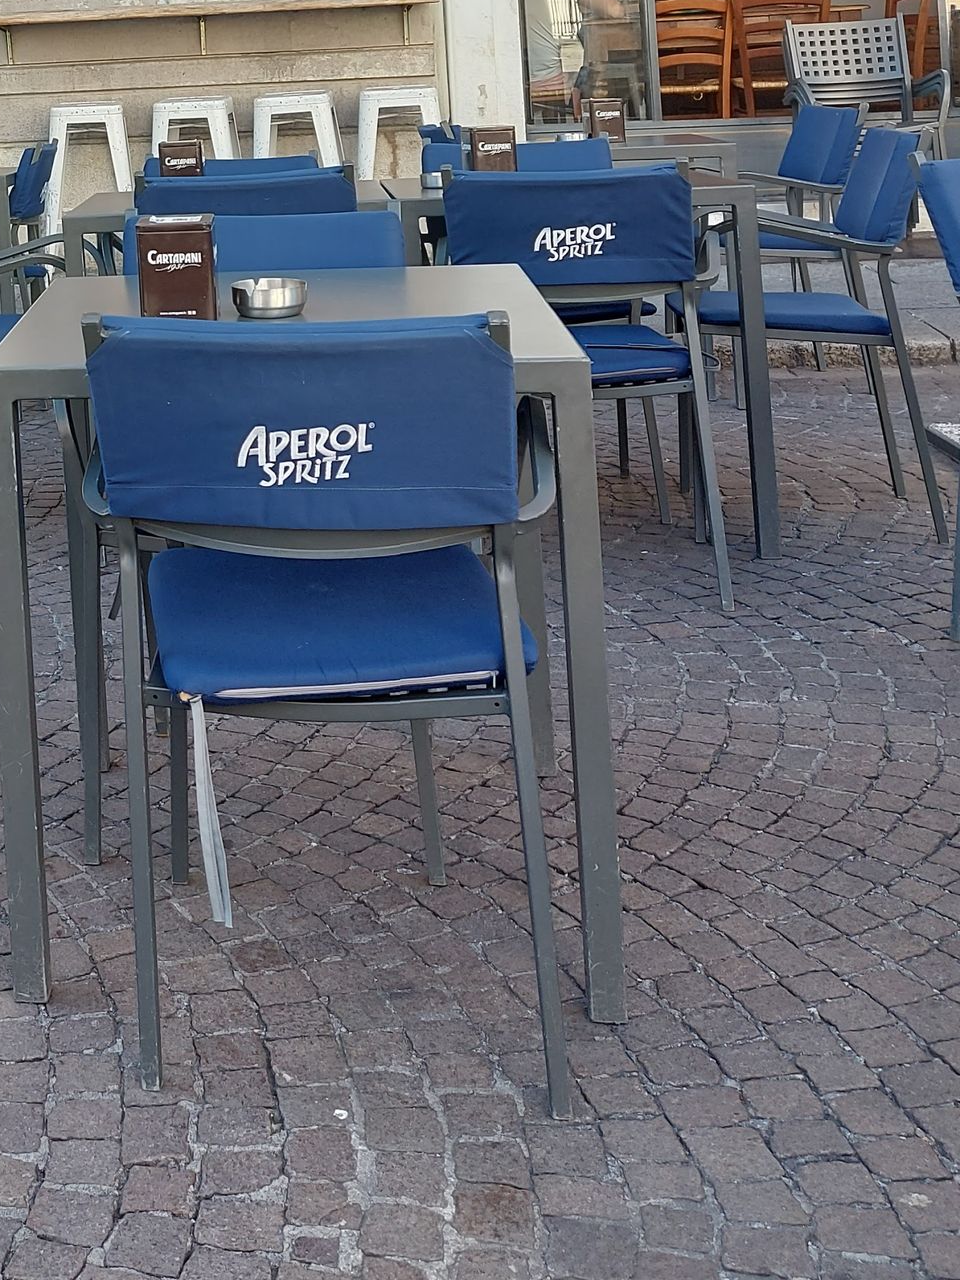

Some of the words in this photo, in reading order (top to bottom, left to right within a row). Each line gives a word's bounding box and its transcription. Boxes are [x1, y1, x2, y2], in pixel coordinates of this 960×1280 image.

[533, 222, 616, 252] APEROL
[147, 249, 202, 265] CARTAPANI
[236, 423, 374, 468] APEROL
